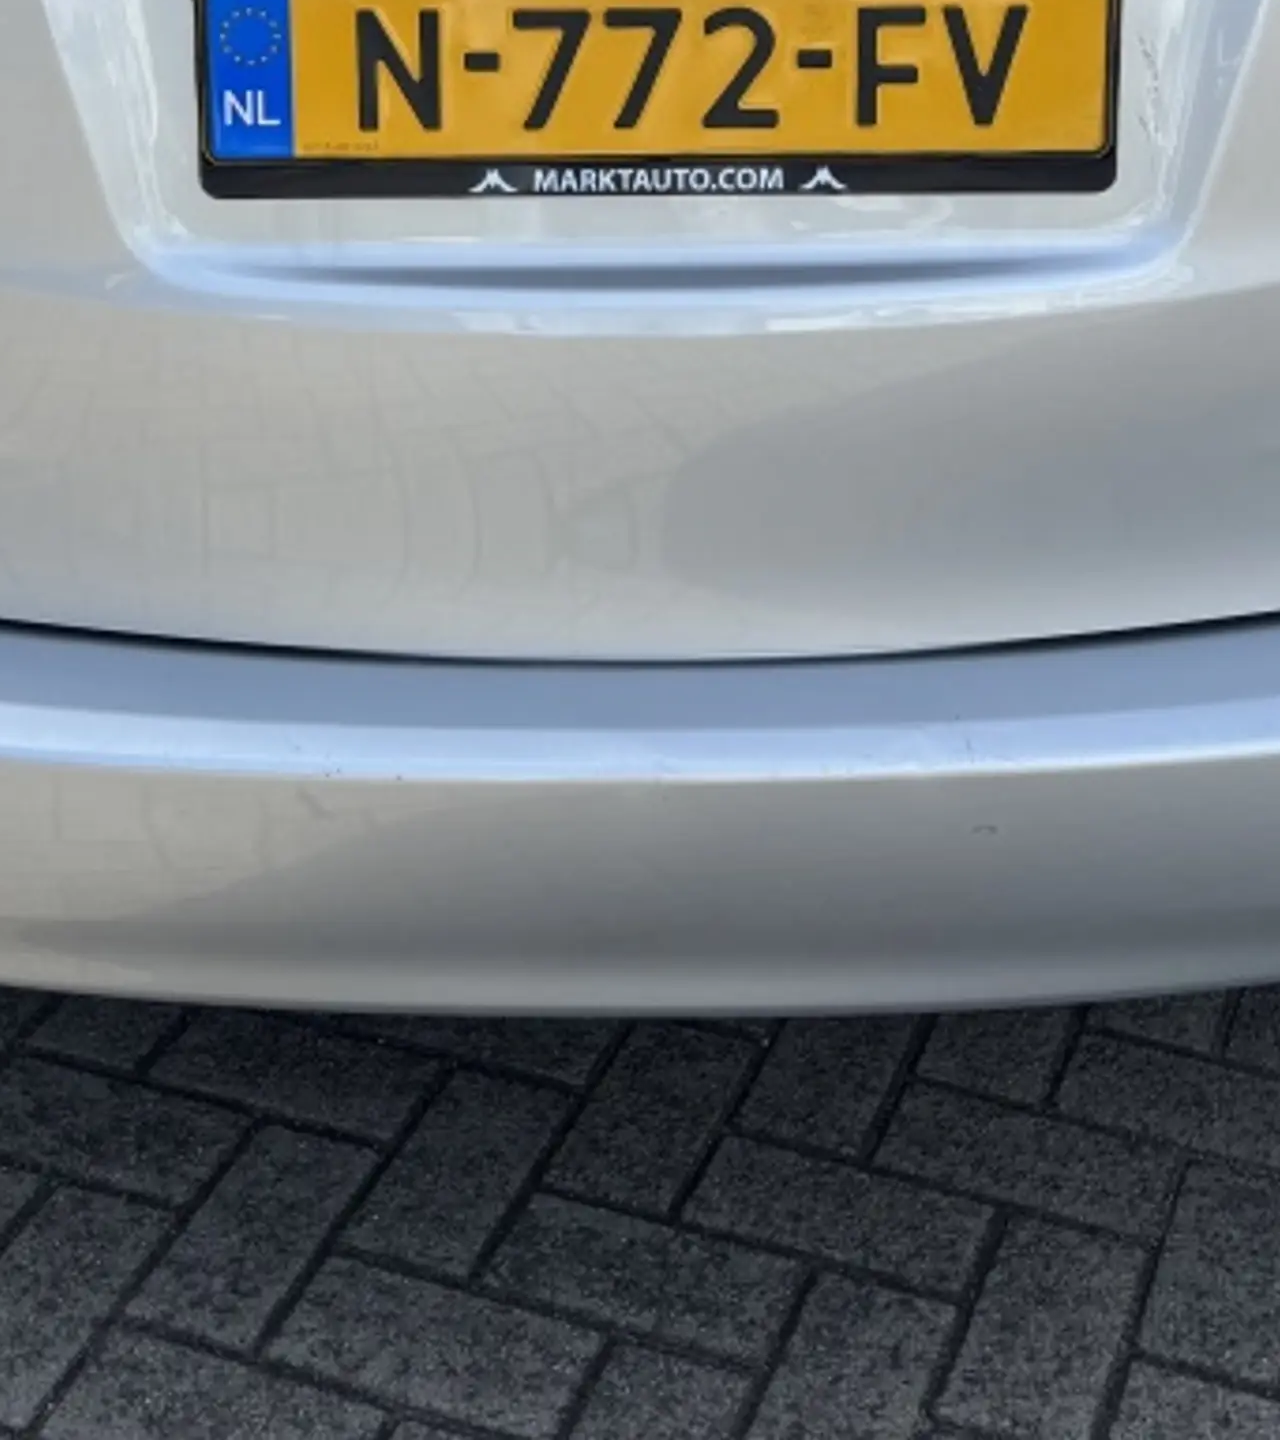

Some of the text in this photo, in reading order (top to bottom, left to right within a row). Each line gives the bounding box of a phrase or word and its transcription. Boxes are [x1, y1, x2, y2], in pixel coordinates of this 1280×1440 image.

[355, 4, 1029, 132] N-772-FV
[223, 89, 281, 127] NL
[532, 167, 785, 192] MARKTAUTO.COM
